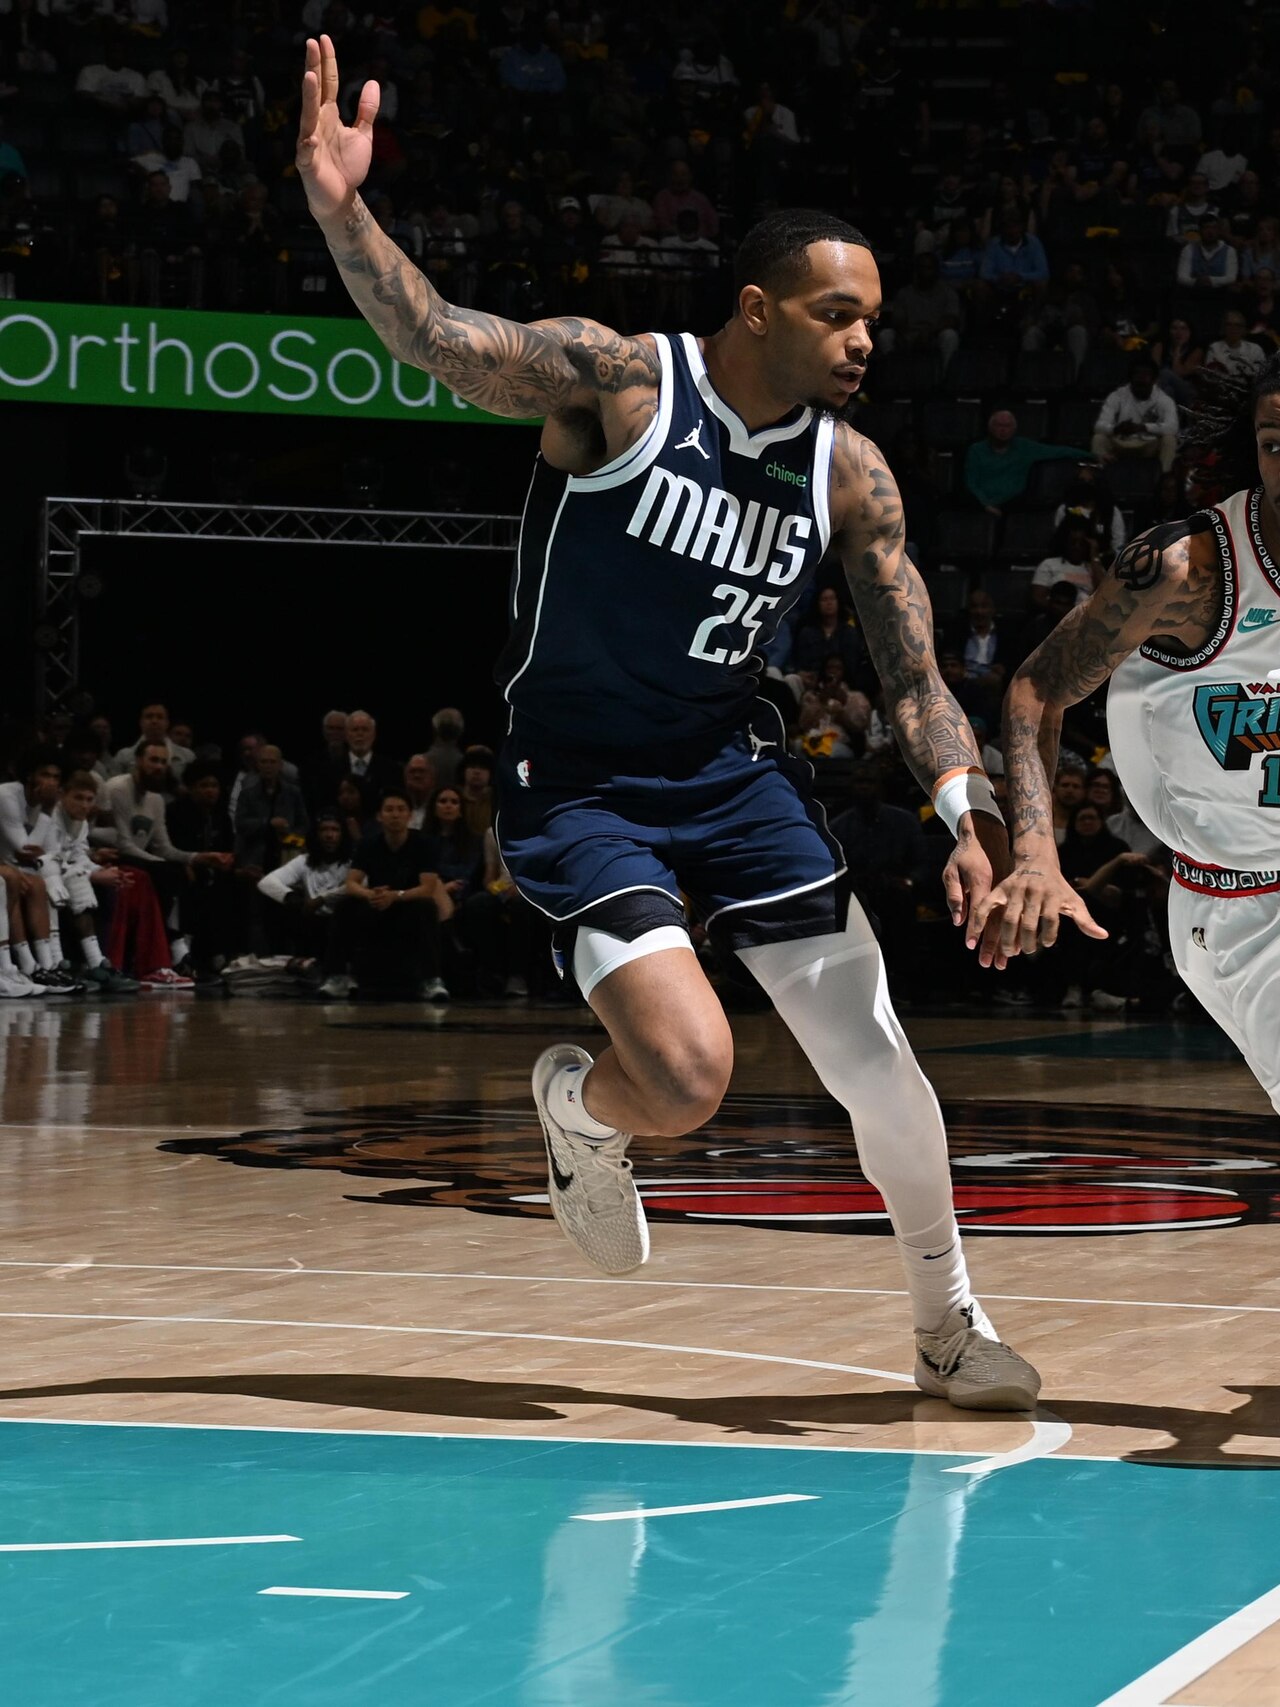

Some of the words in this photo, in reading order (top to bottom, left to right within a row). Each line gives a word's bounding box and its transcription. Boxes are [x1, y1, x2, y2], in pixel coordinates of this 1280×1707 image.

[765, 461, 807, 487] chime
[626, 465, 812, 586] MAVS
[688, 583, 782, 666] 25
[1244, 607, 1277, 623] NIKE
